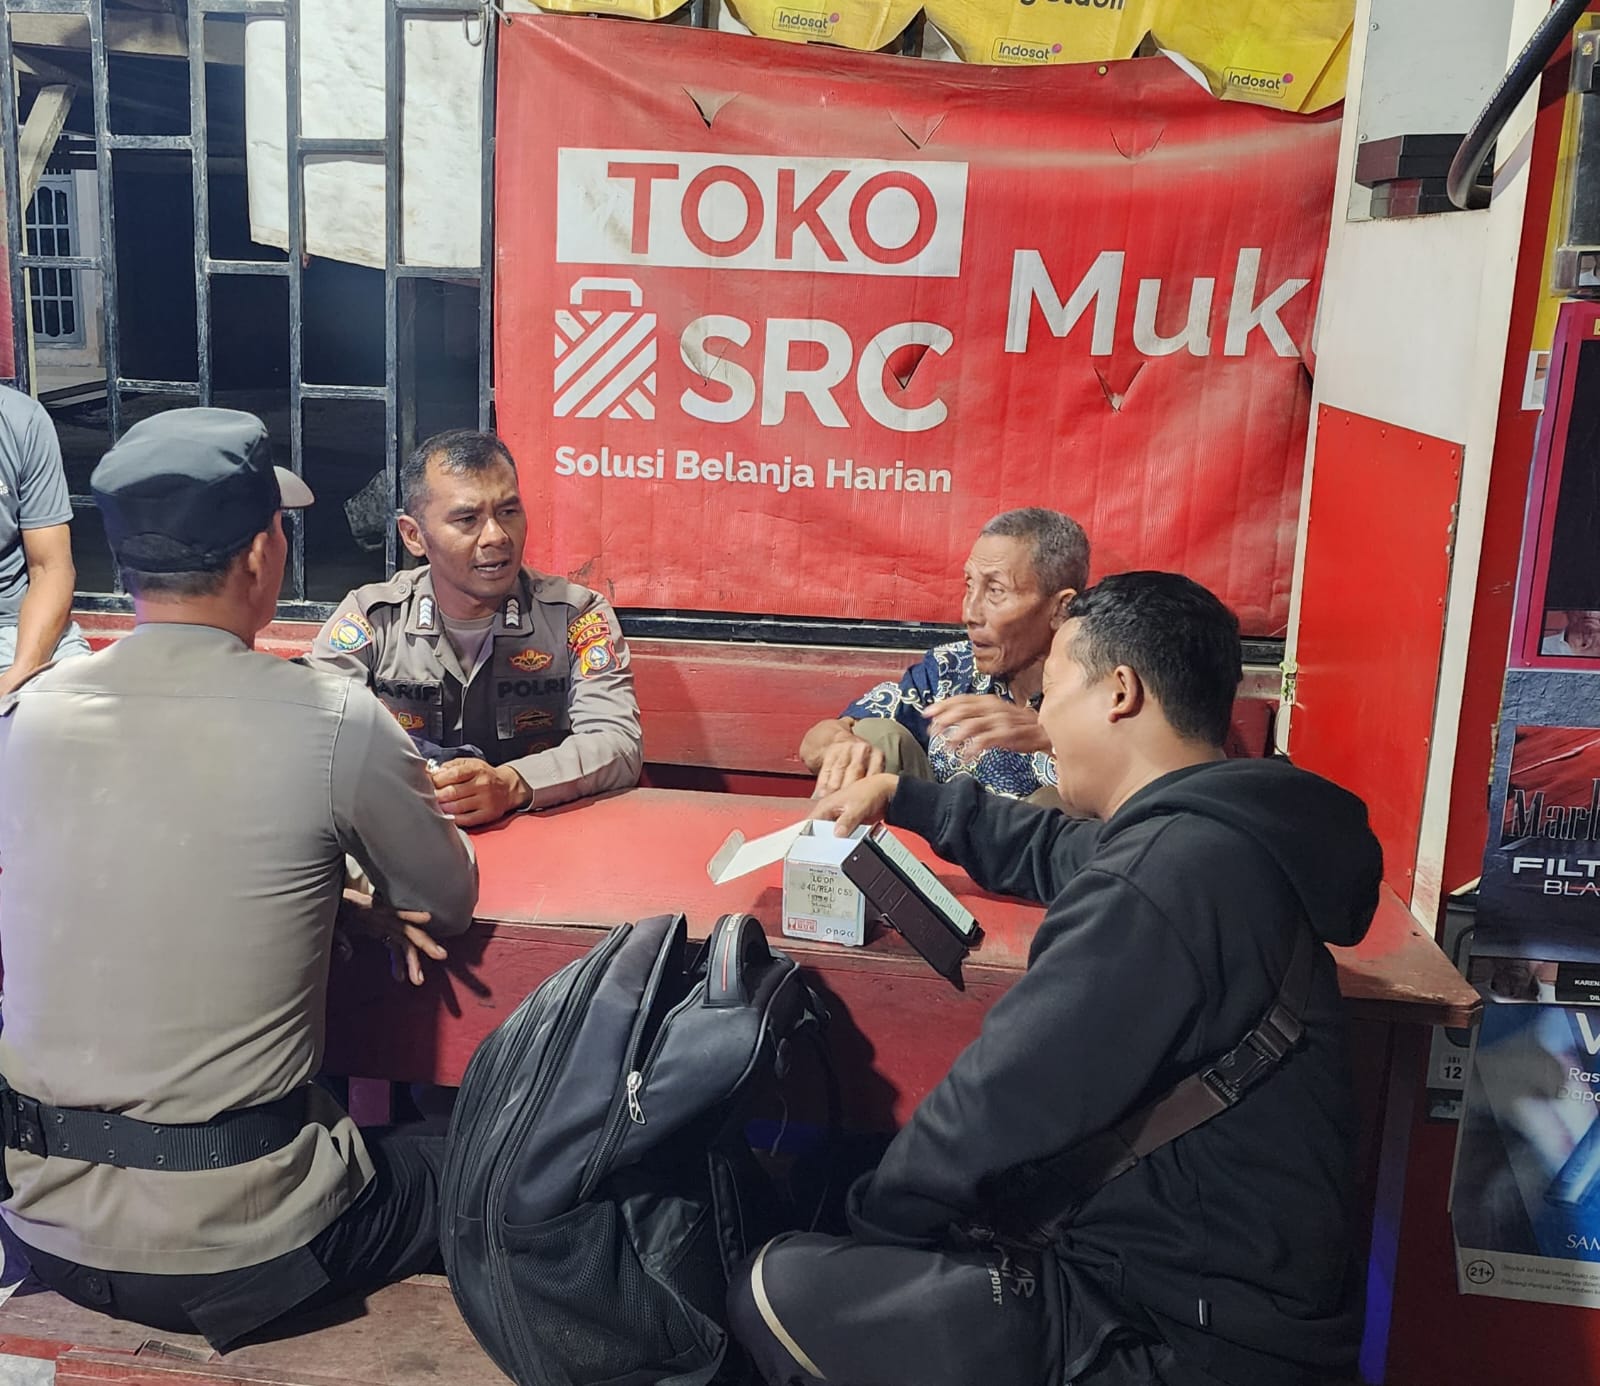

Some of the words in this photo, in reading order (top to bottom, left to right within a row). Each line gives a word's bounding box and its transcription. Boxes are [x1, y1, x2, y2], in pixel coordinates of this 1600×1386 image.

[779, 11, 828, 29] Indosat
[999, 42, 1050, 60] Indosat
[1229, 71, 1280, 90] Indosat
[607, 161, 938, 265] TOKO
[1004, 247, 1317, 358] Muk
[679, 314, 954, 432] SRC
[554, 446, 665, 479] Solusi
[675, 449, 815, 493] Belanja
[826, 458, 952, 493] Harian
[497, 677, 566, 699] POLRI
[1444, 1066, 1462, 1079] 12
[1471, 1267, 1491, 1277] 21+
